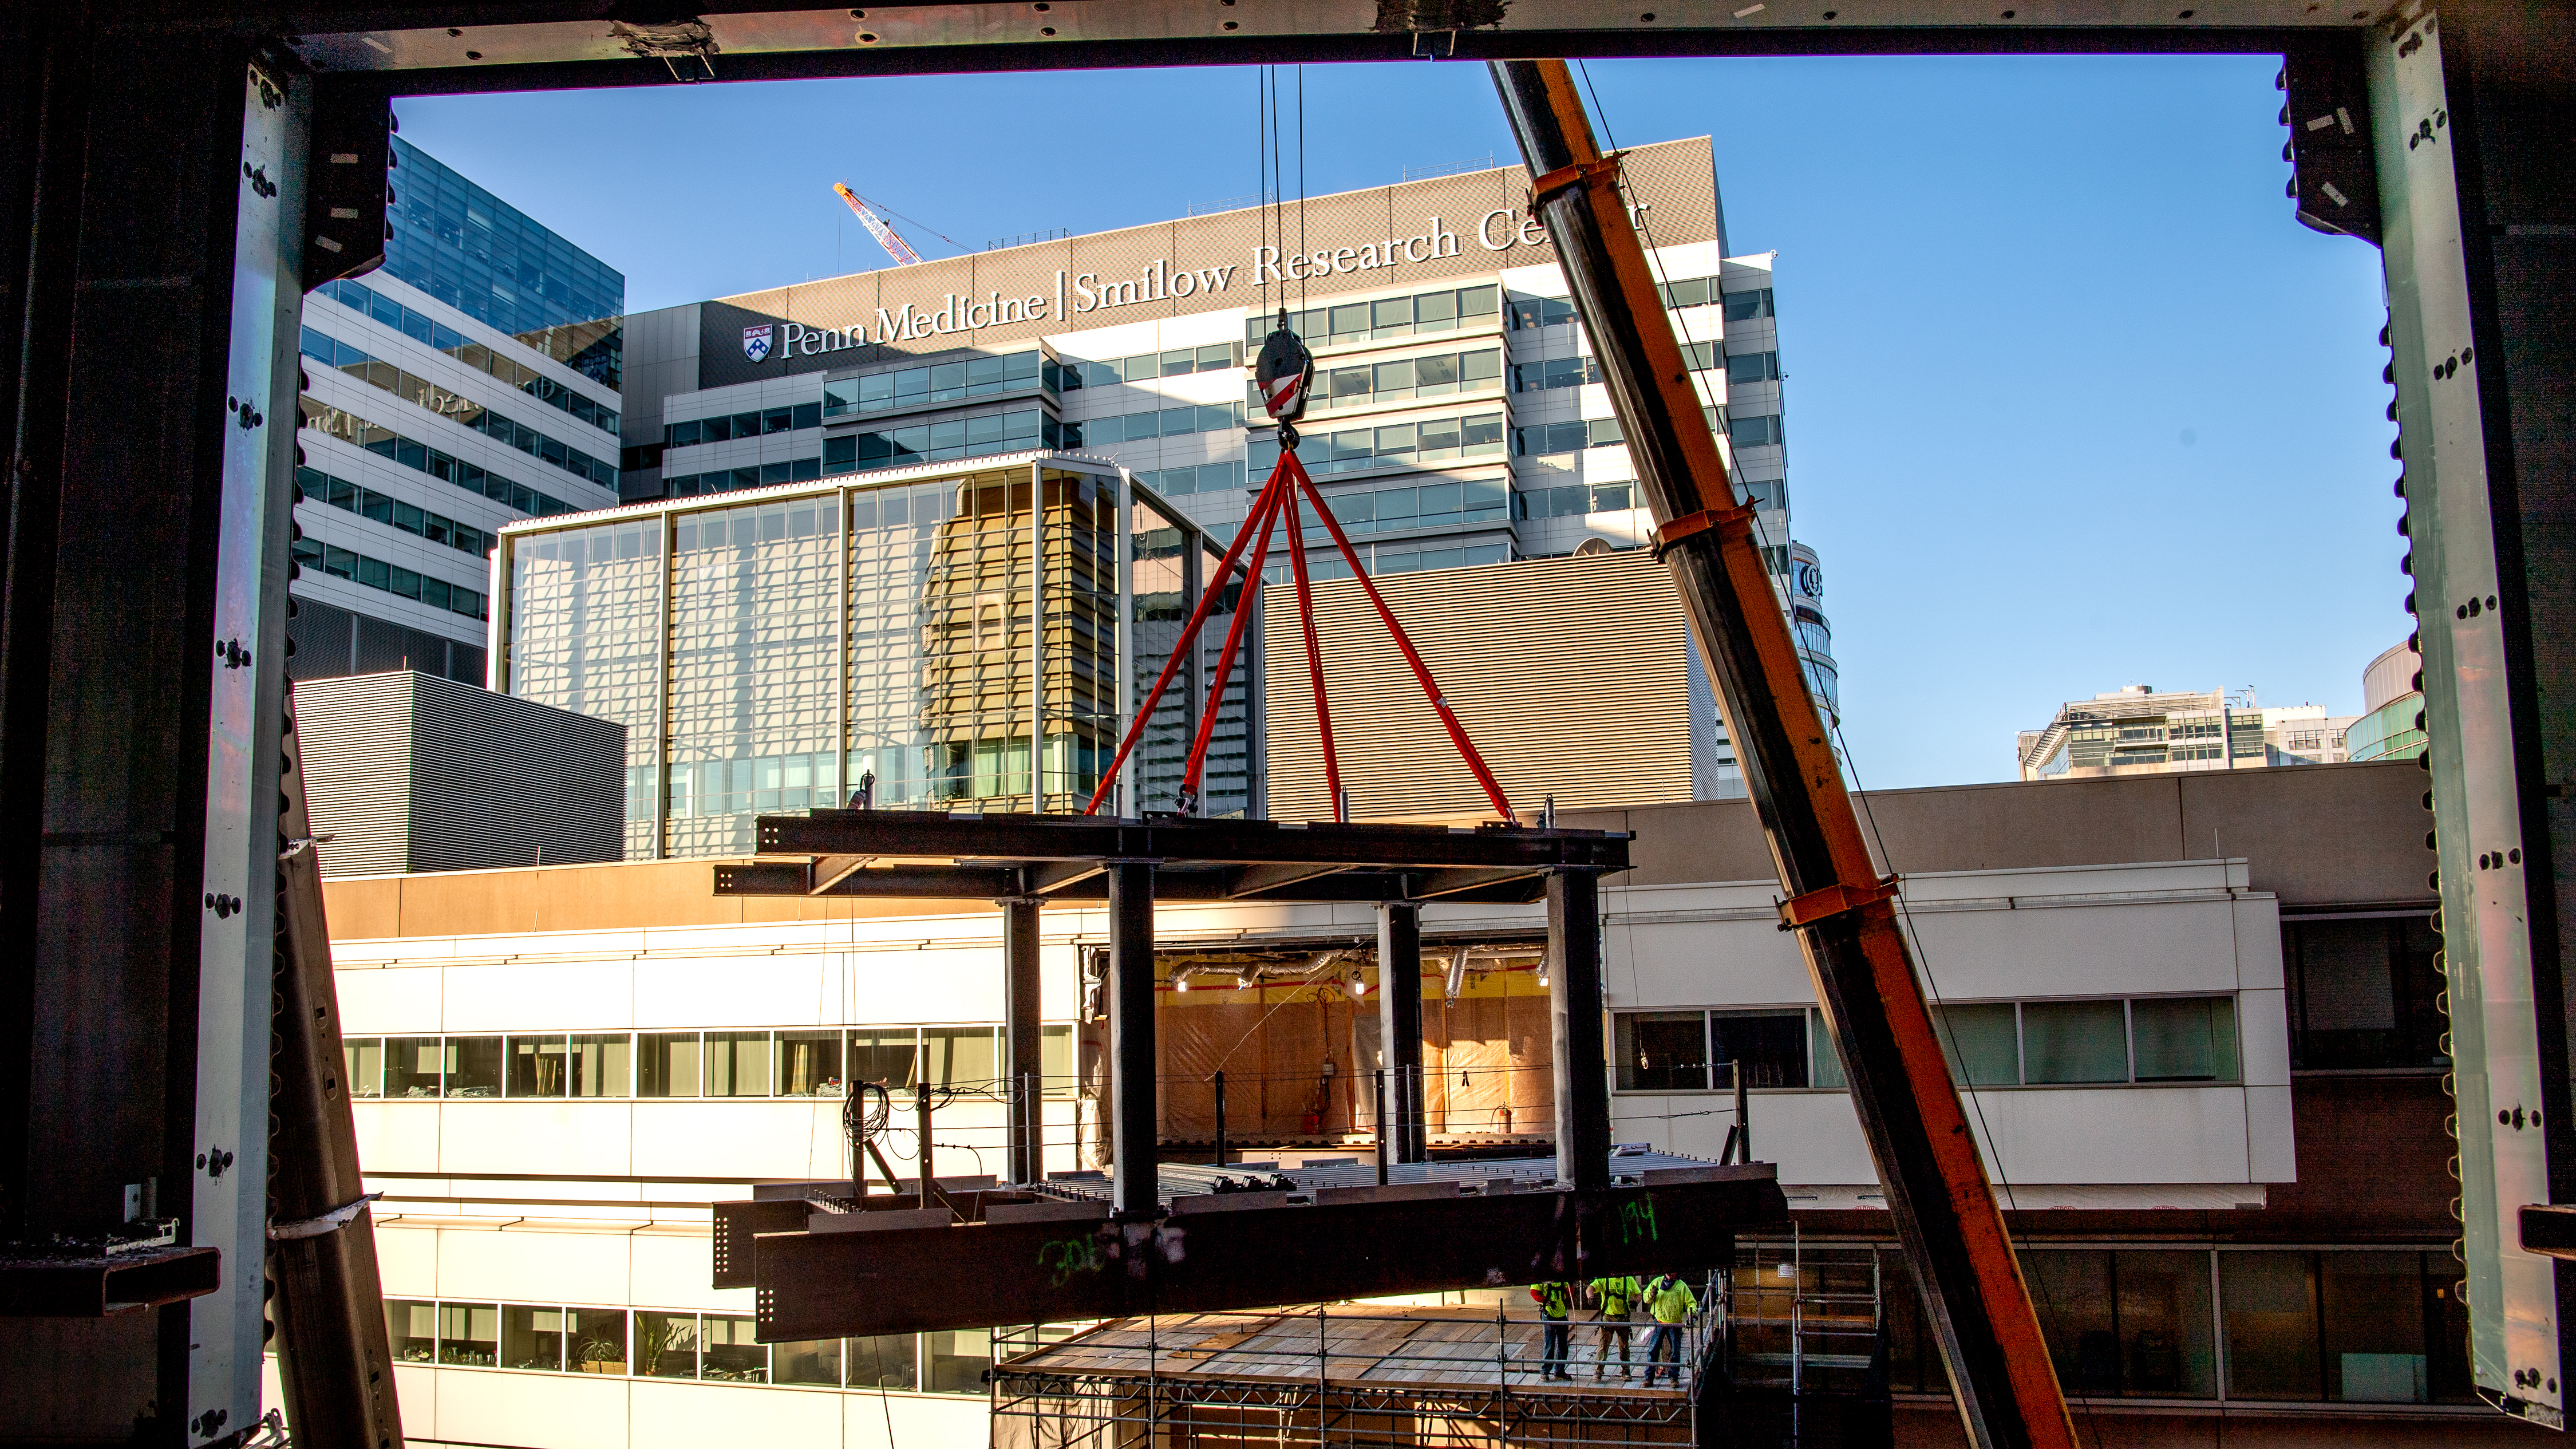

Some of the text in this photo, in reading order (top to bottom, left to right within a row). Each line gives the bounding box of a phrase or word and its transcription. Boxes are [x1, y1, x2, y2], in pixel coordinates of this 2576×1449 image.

[781, 203, 1650, 359] Penn Medicine Smilow Research Cer
